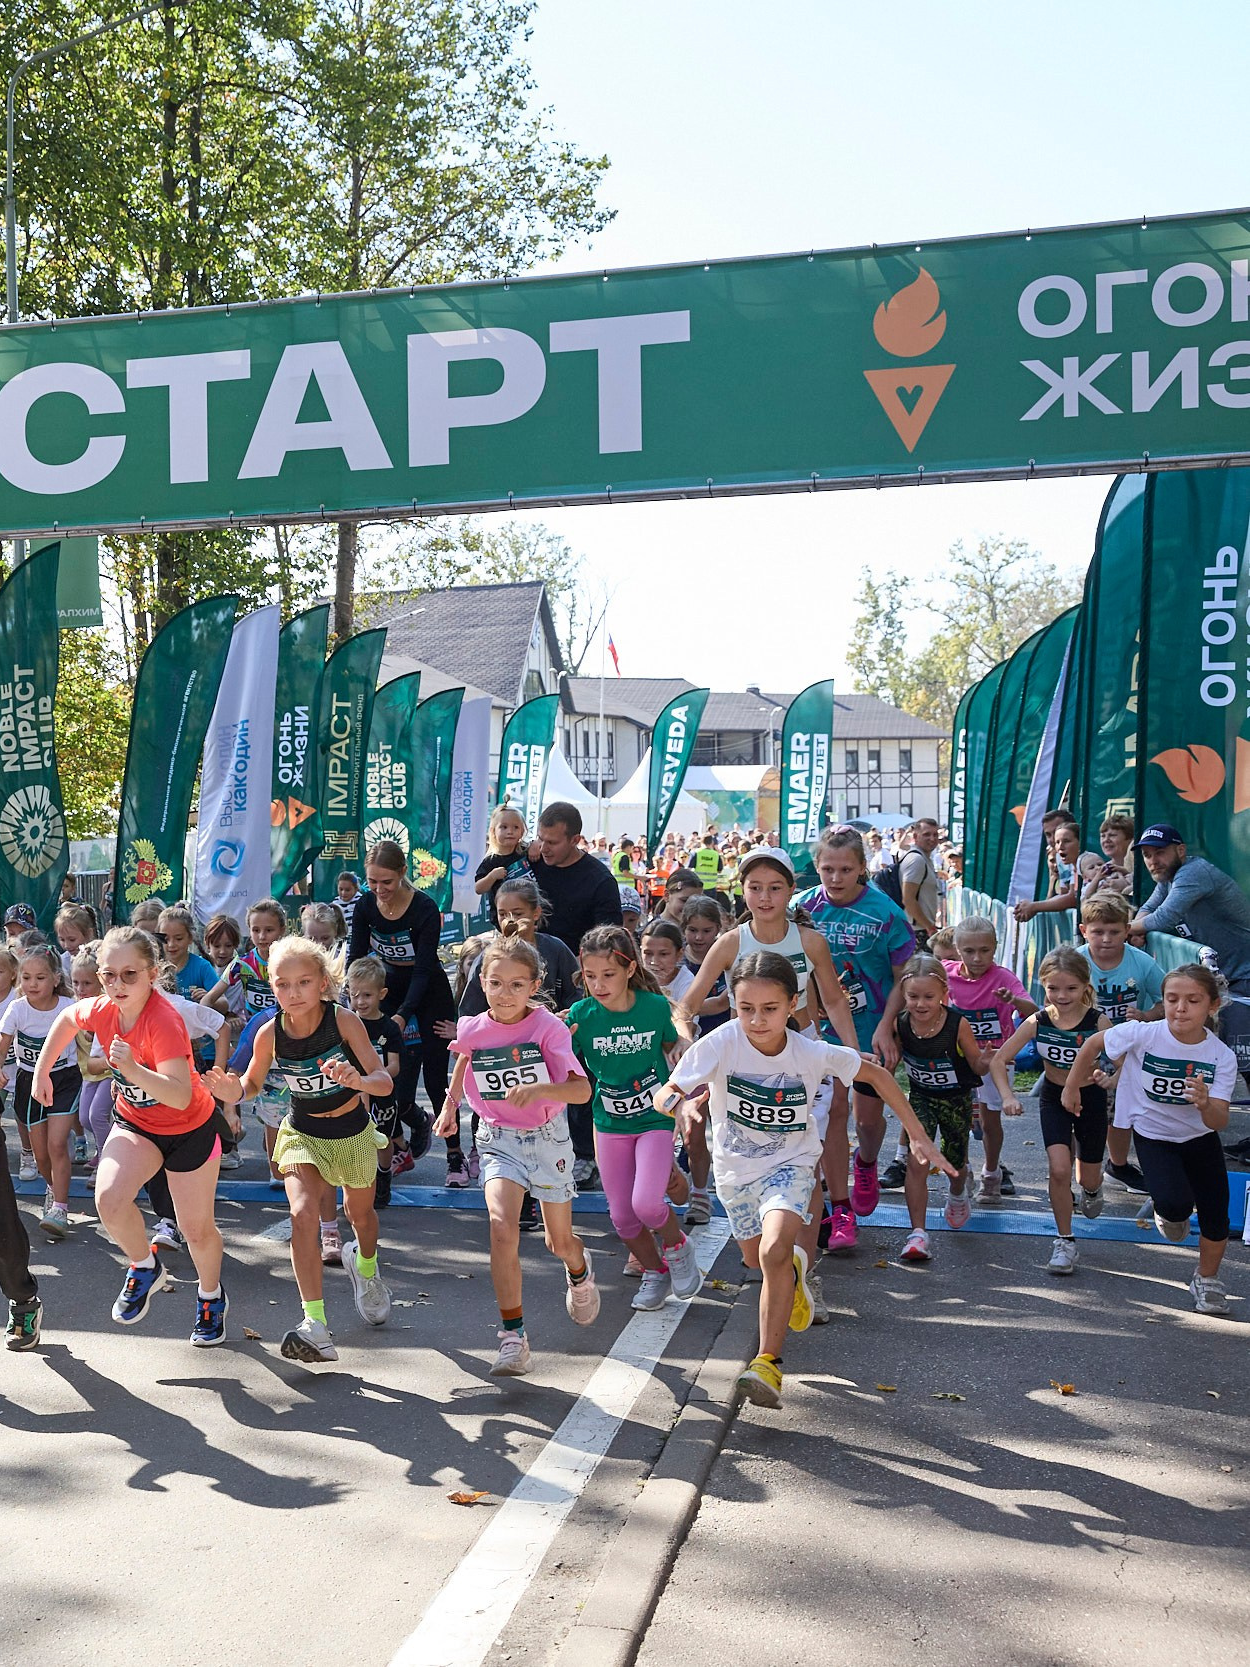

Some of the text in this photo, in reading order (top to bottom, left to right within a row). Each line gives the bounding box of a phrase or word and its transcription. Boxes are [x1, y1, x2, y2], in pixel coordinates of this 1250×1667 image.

[57, 608, 100, 617] АЛХИМ
[1200, 545, 1239, 707] ОГОНЬ
[0, 682, 21, 772] NOBLE
[14, 664, 42, 771] IMPACT
[278, 712, 292, 783] ОГОНЬ
[292, 706, 309, 787] ЖИЗНИ
[328, 693, 351, 816] IMPACT
[351, 694, 364, 817] БЛАГОТВОРИТЕЛЬНЫЙ ФОНД
[532, 749, 541, 778] ЛЕТ
[816, 738, 825, 769] ЛЕТ
[367, 752, 380, 809] NOBLE
[379, 741, 393, 809] IMPACT
[392, 761, 406, 809] CLUB
[788, 732, 810, 821] MAER
[815, 775, 823, 796] 20
[253, 994, 275, 1007] 85
[1048, 1046, 1078, 1062] 89
[485, 1066, 538, 1091] 965
[911, 1067, 948, 1085] 828
[1152, 1078, 1186, 1096] 89
[613, 1090, 653, 1113] 841
[739, 1100, 796, 1123] 889
